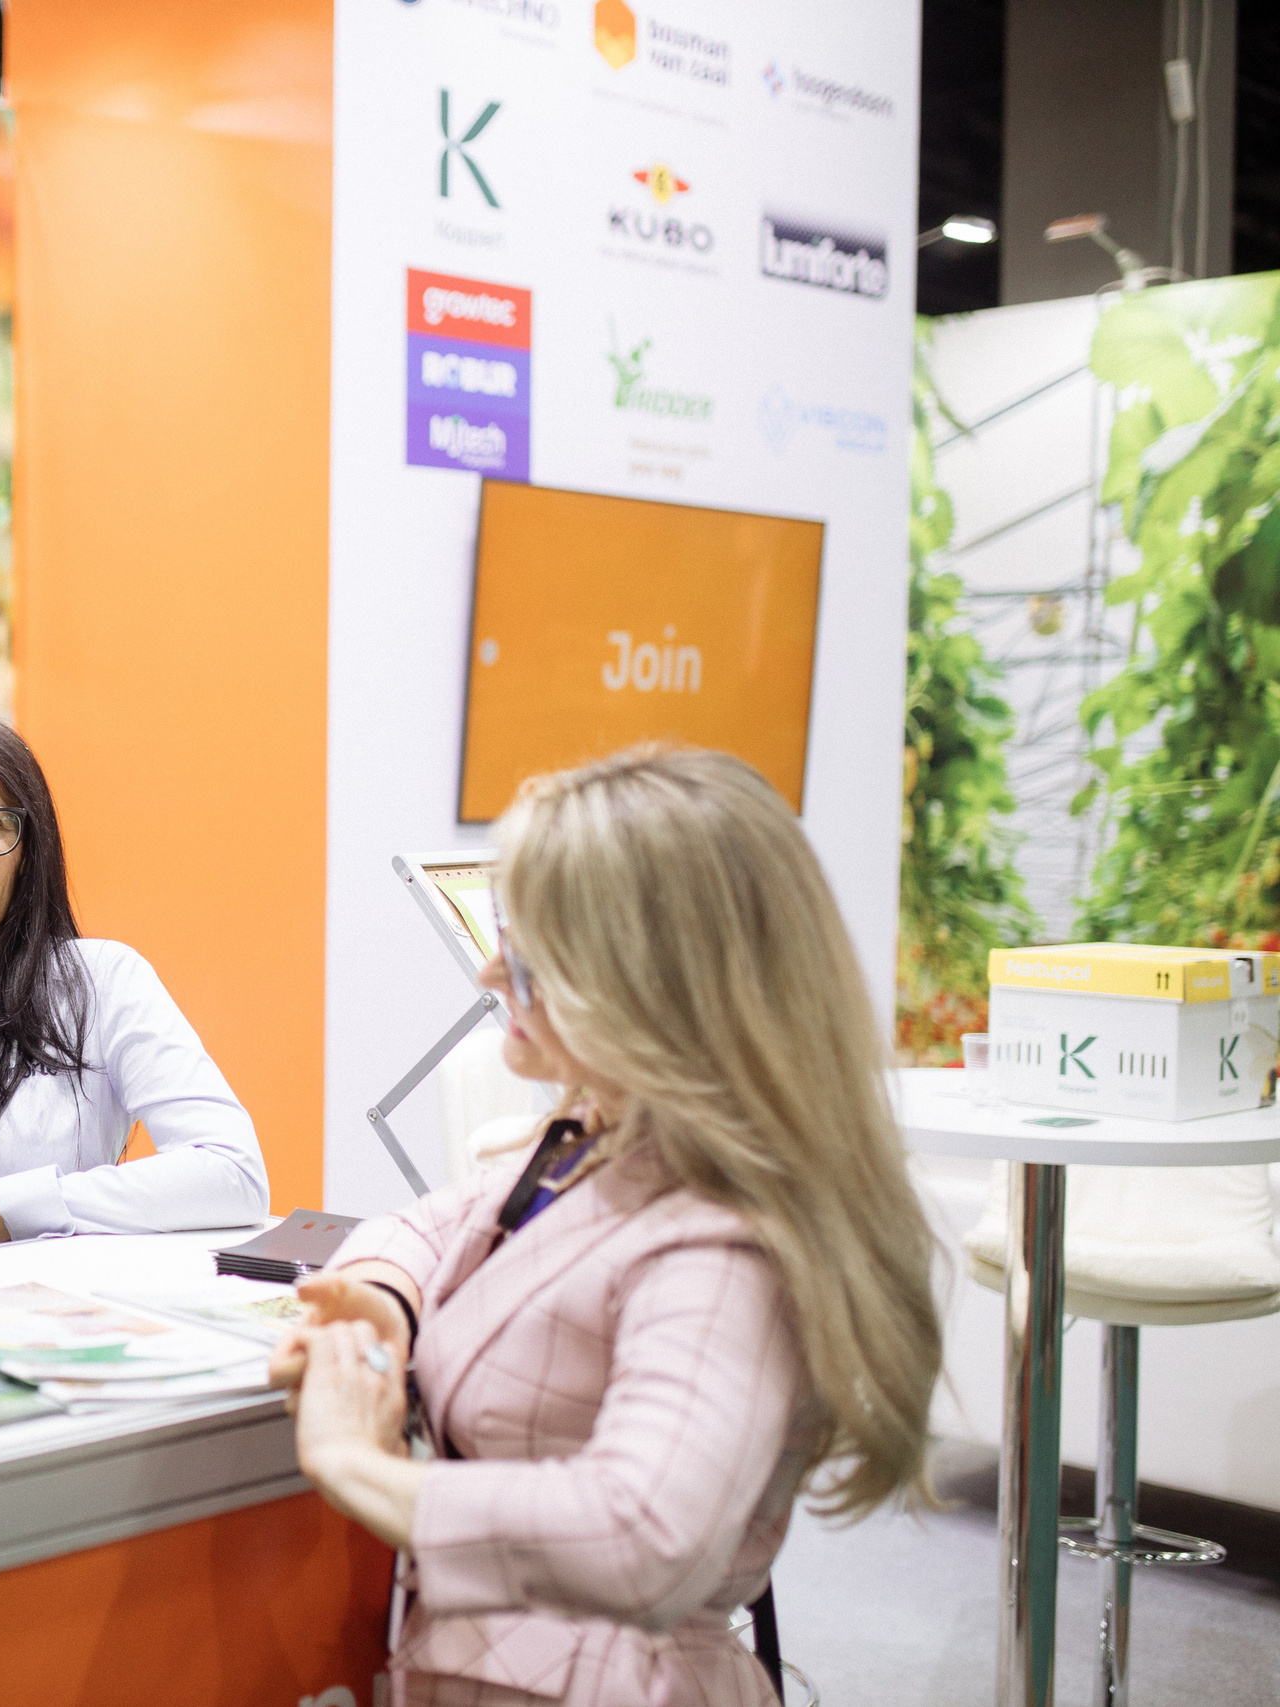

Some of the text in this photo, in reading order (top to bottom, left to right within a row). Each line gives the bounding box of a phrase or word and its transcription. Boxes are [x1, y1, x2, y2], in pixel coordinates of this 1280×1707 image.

[608, 204, 716, 255] KUBO
[601, 623, 703, 694] Join
[1005, 958, 1091, 983] Natupol
